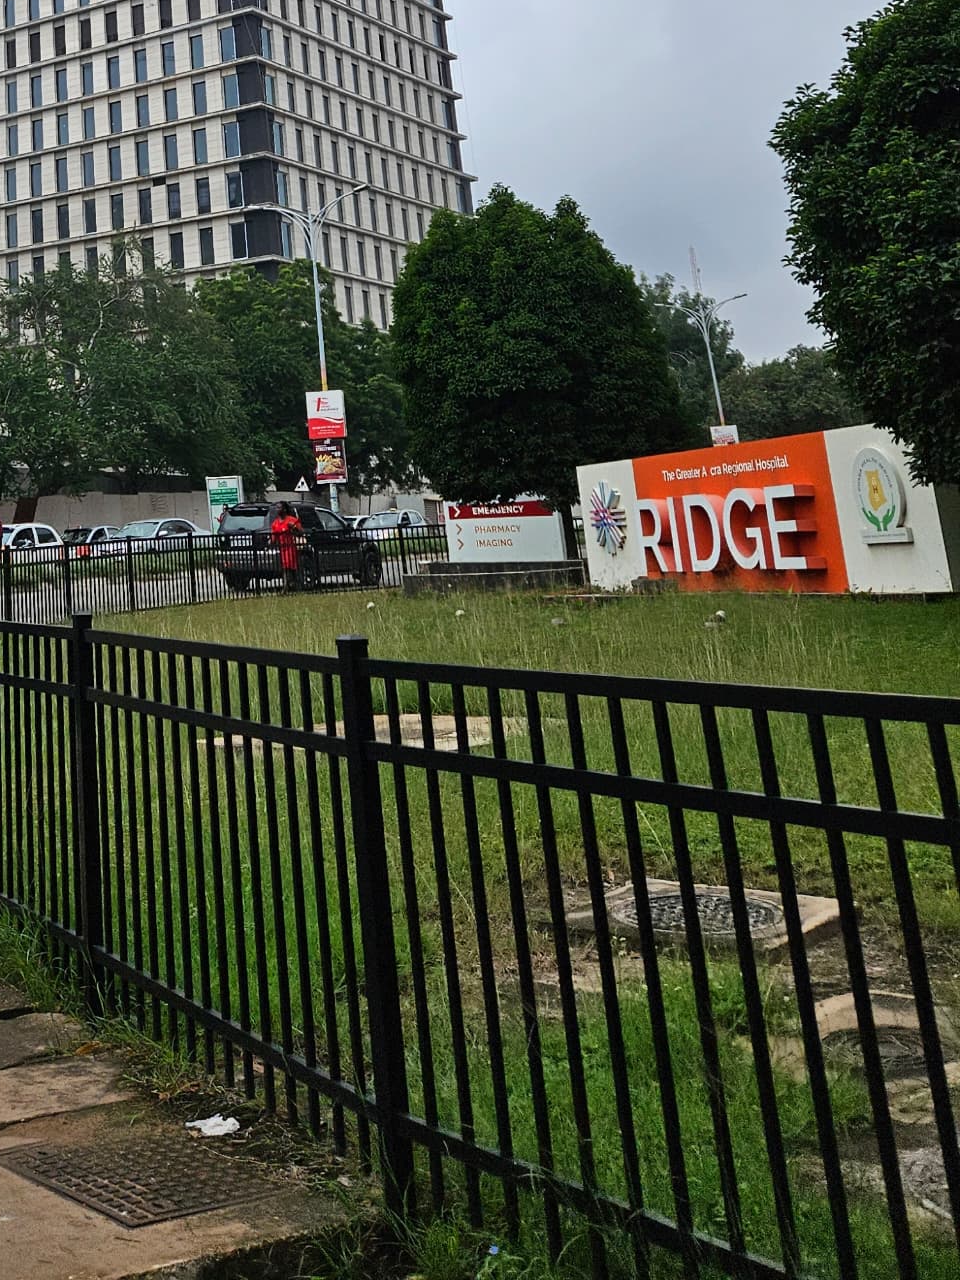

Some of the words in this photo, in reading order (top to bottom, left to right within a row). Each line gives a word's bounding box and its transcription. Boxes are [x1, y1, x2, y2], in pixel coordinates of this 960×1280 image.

[662, 470, 675, 482] The
[676, 468, 700, 480] Greater
[723, 460, 754, 476] Regional
[755, 454, 789, 473] Hospital
[475, 525, 521, 534] PHARMACY
[637, 484, 808, 577] RIDGE
[476, 538, 513, 548] IMAGING
